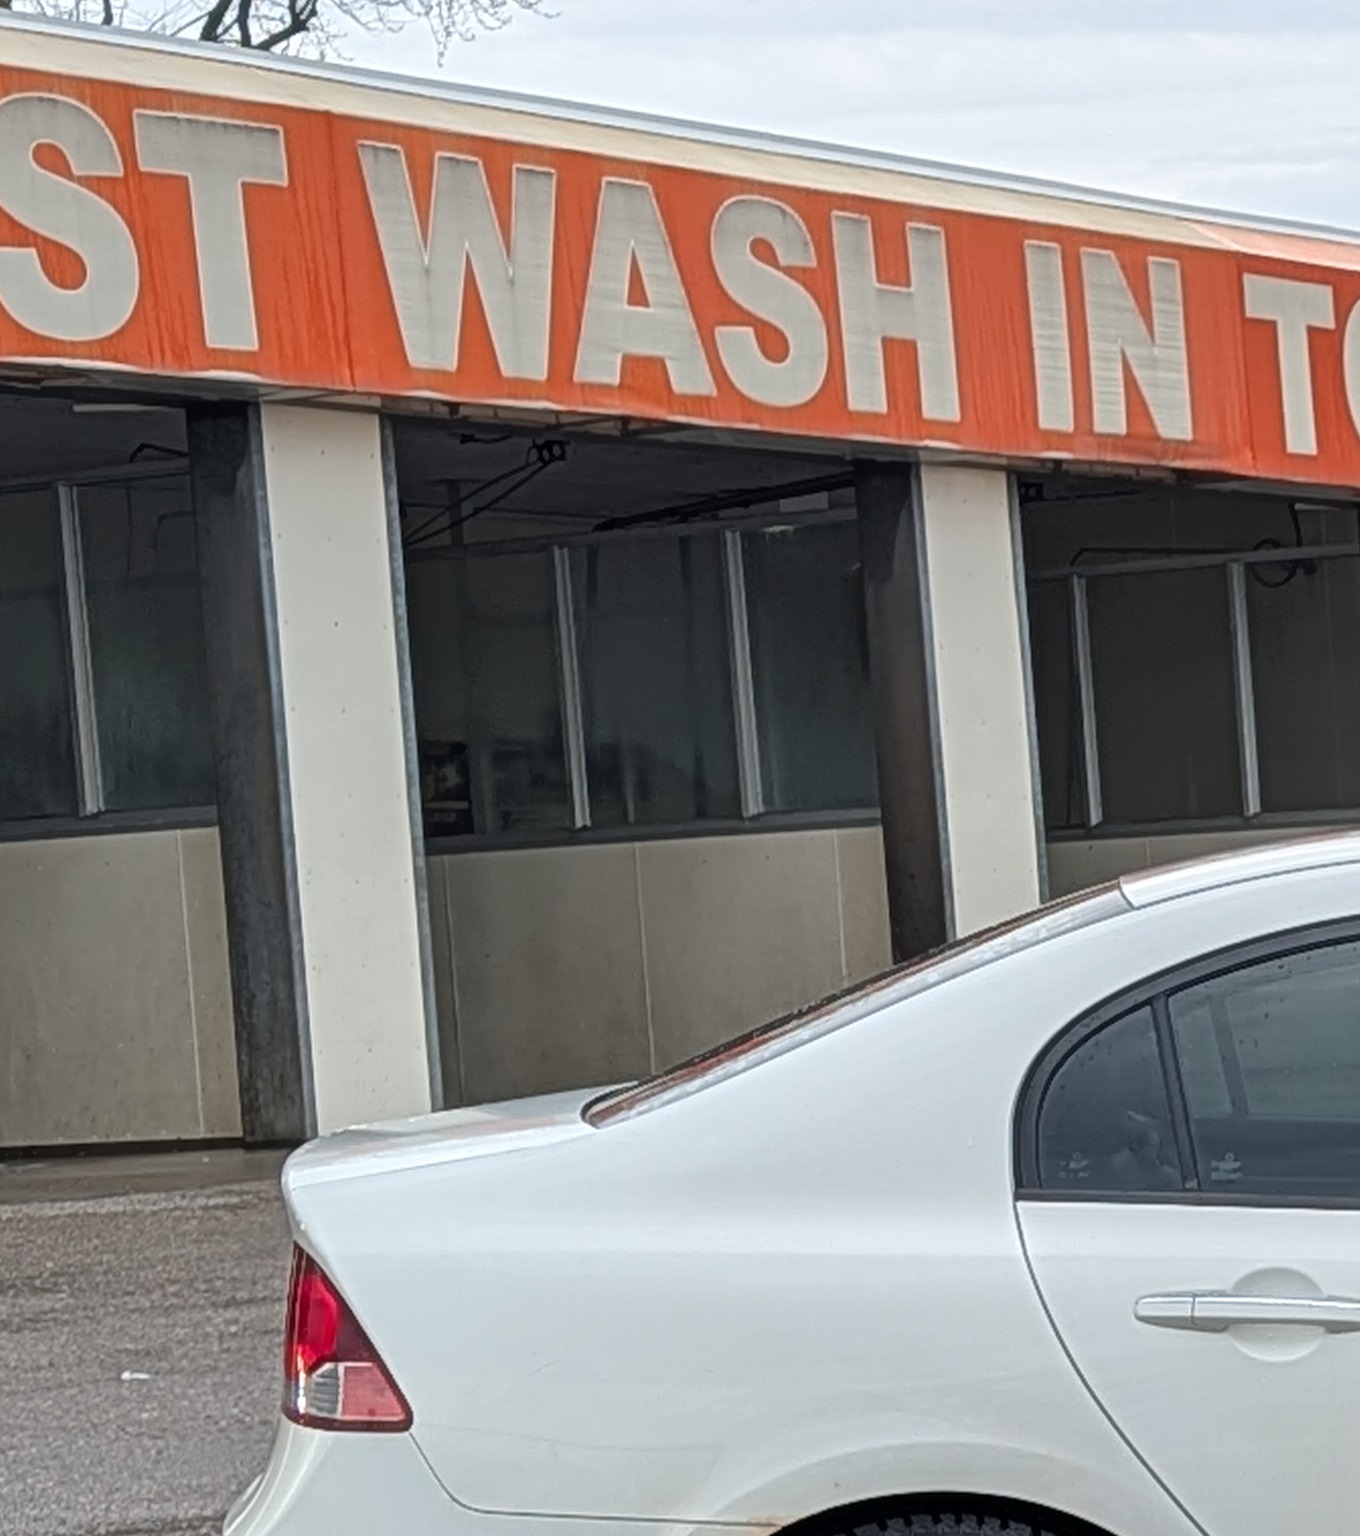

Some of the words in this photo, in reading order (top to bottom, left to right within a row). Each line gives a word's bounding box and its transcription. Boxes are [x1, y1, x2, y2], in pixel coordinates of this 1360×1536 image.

[0, 92, 289, 351] ST
[357, 141, 961, 423] WASH
[1023, 238, 1194, 442] IN
